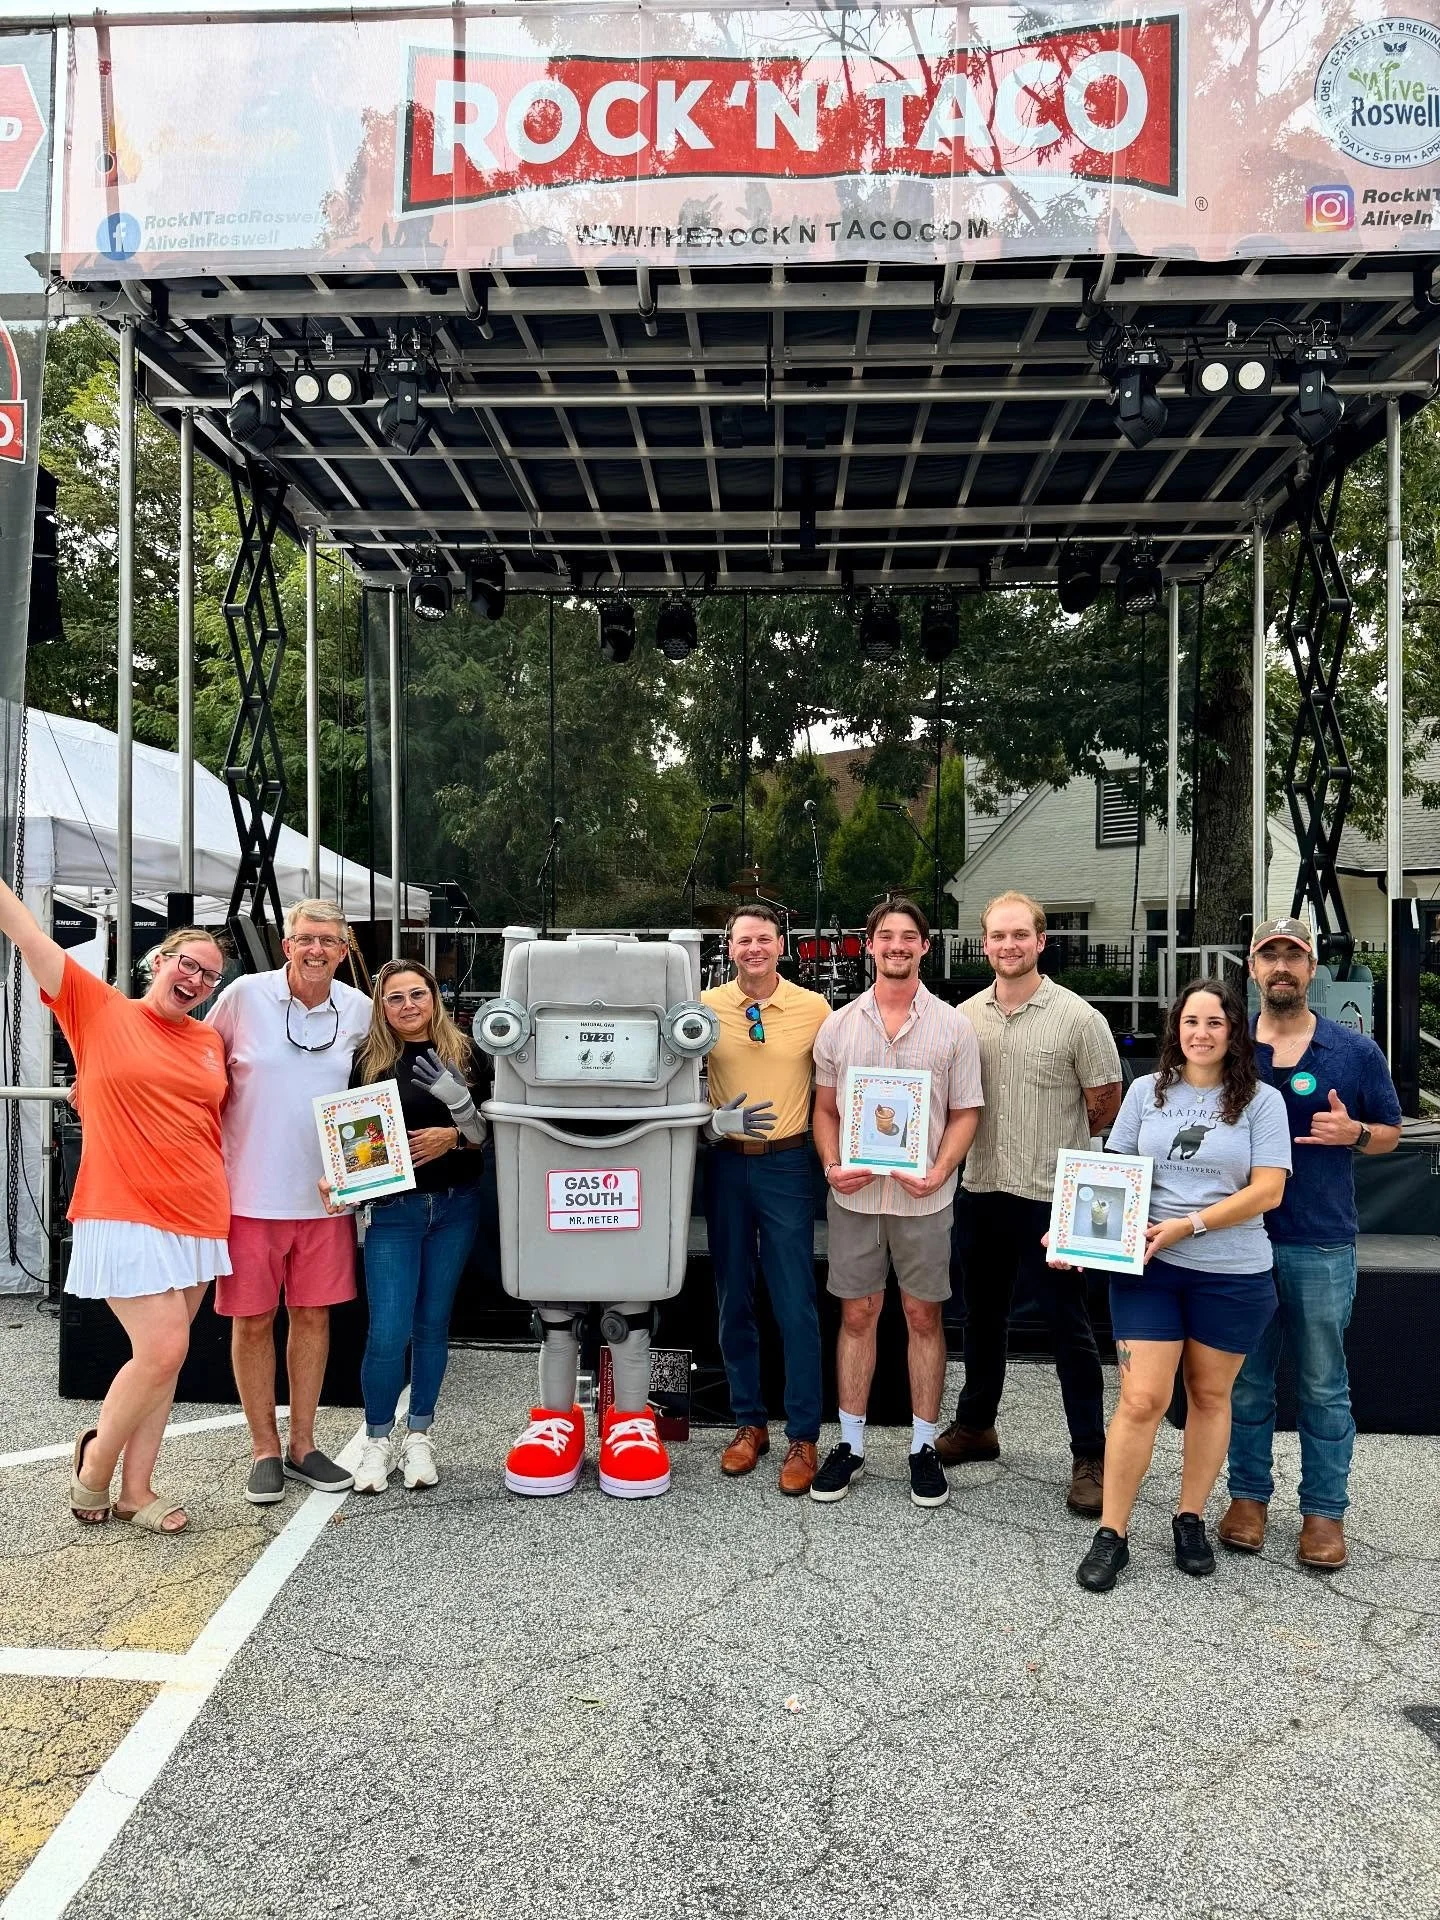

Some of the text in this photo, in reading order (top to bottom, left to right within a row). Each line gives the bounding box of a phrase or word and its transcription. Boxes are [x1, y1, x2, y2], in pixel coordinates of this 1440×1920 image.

[1361, 22, 1395, 40] CITY
[1398, 22, 1440, 50] BREWIN
[1320, 79, 1332, 102] 3RD
[1360, 64, 1425, 103] Alive
[431, 78, 715, 177] ROCK
[862, 49, 1149, 155] TACO
[1351, 94, 1440, 128] Roswell
[1372, 140, 1440, 164] 5-9 PM APR
[581, 1033, 613, 1041] 0720
[1186, 1166, 1222, 1175] TAVERNA
[564, 1176, 600, 1190] GAS
[565, 1192, 623, 1207] SOUTH
